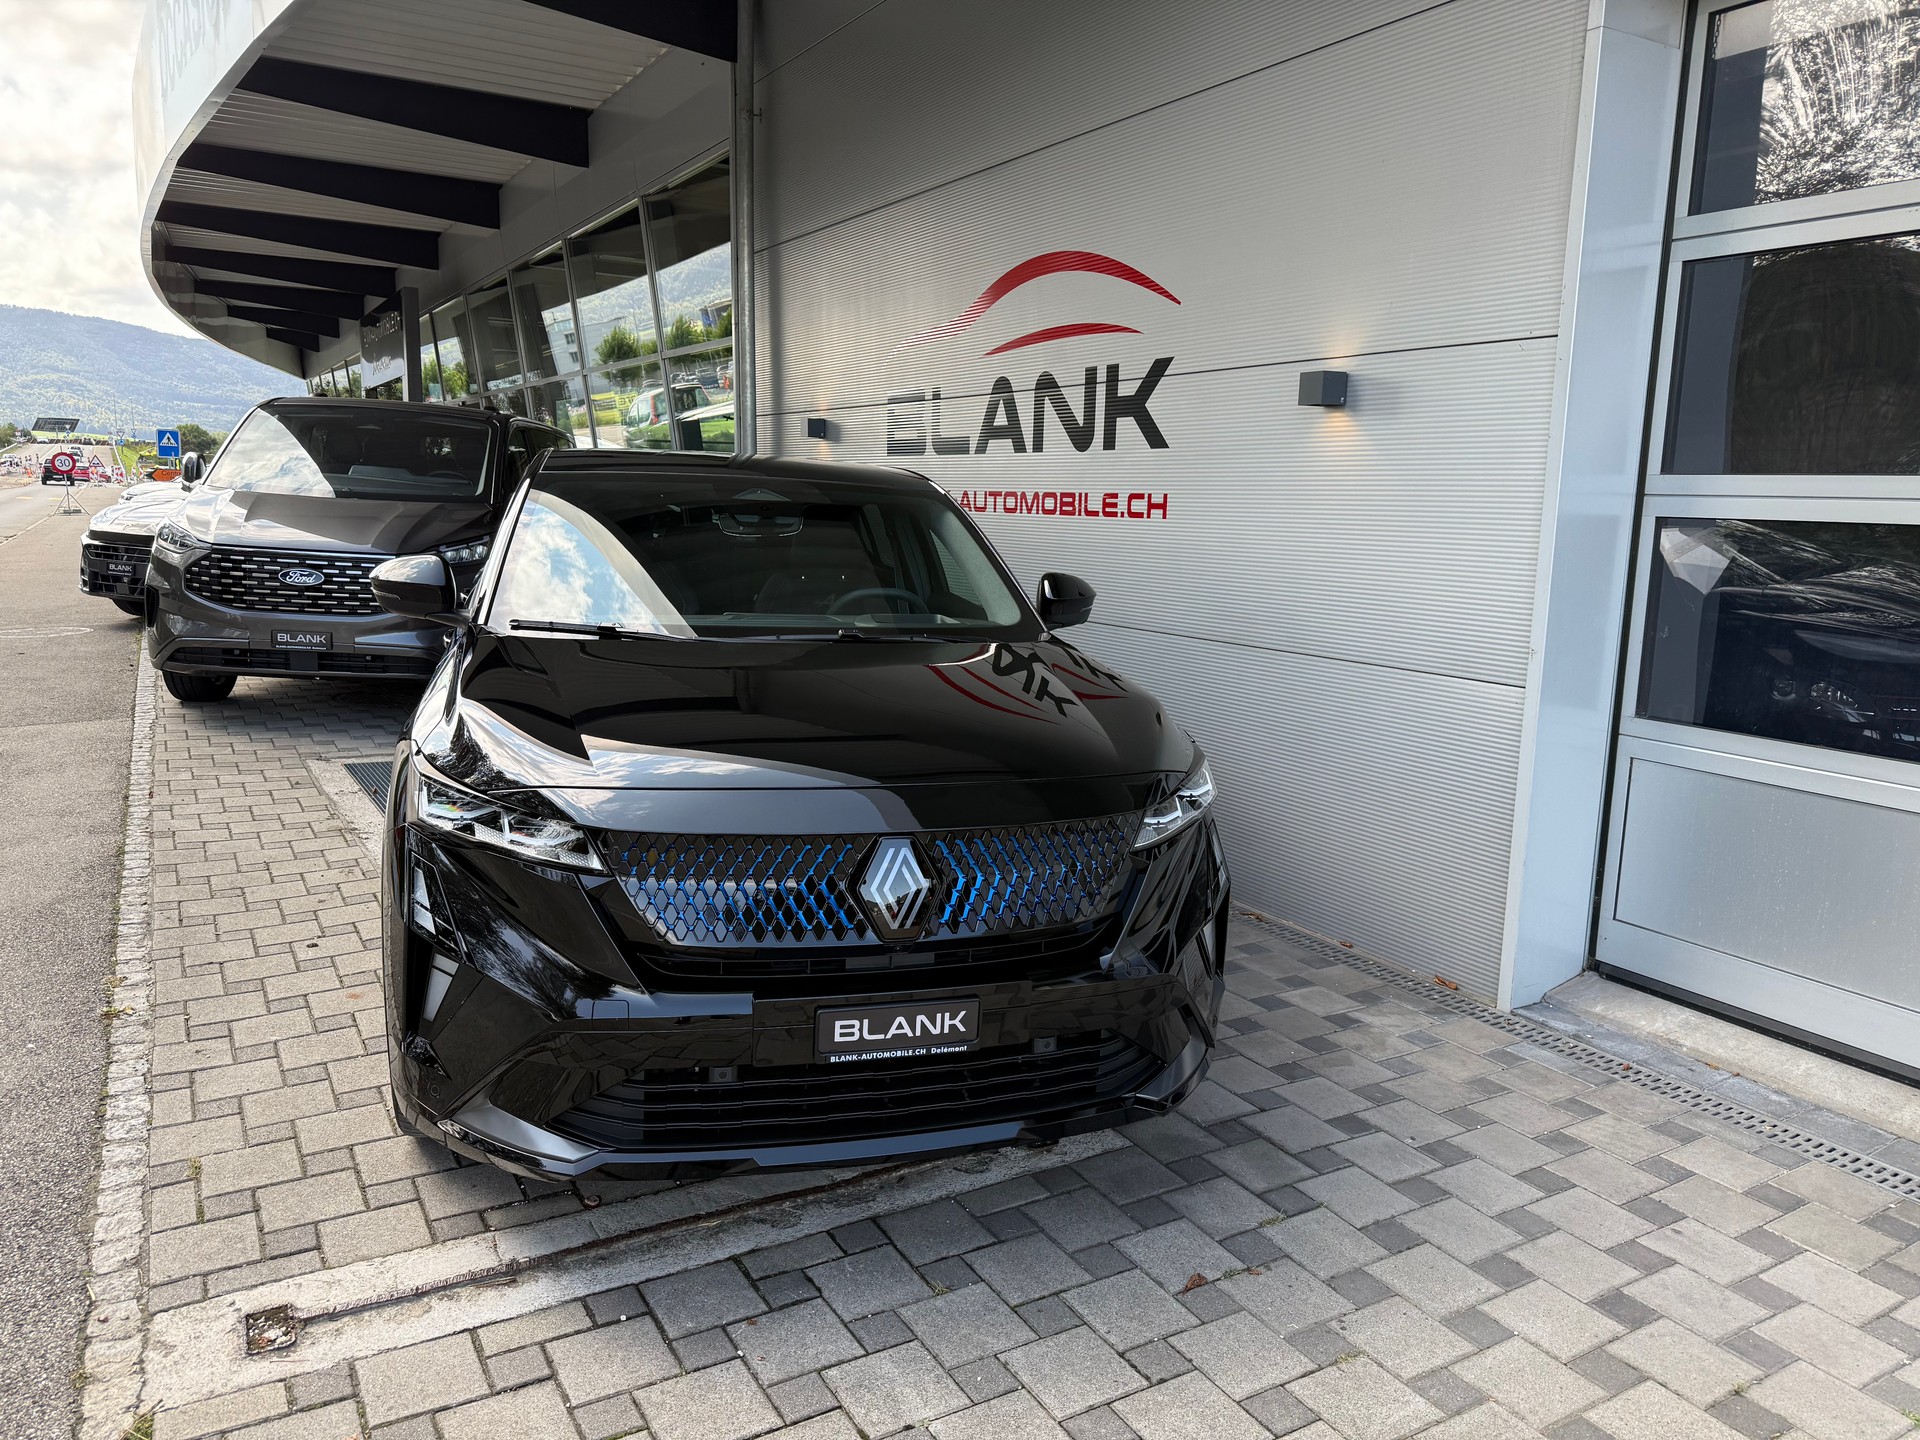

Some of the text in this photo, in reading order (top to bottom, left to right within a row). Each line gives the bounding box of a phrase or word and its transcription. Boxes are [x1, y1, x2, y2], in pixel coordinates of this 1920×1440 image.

[886, 356, 1175, 457] BLANK
[56, 458, 71, 468] 30
[954, 489, 1169, 520] AUTOMOBILE.CH
[109, 563, 133, 572] BLANK
[286, 570, 316, 583] Ford
[277, 633, 327, 644] BLANK
[833, 1010, 967, 1042] BLANK
[830, 1045, 968, 1063] BLANK-AUTOMOBILE.CH Delémont
